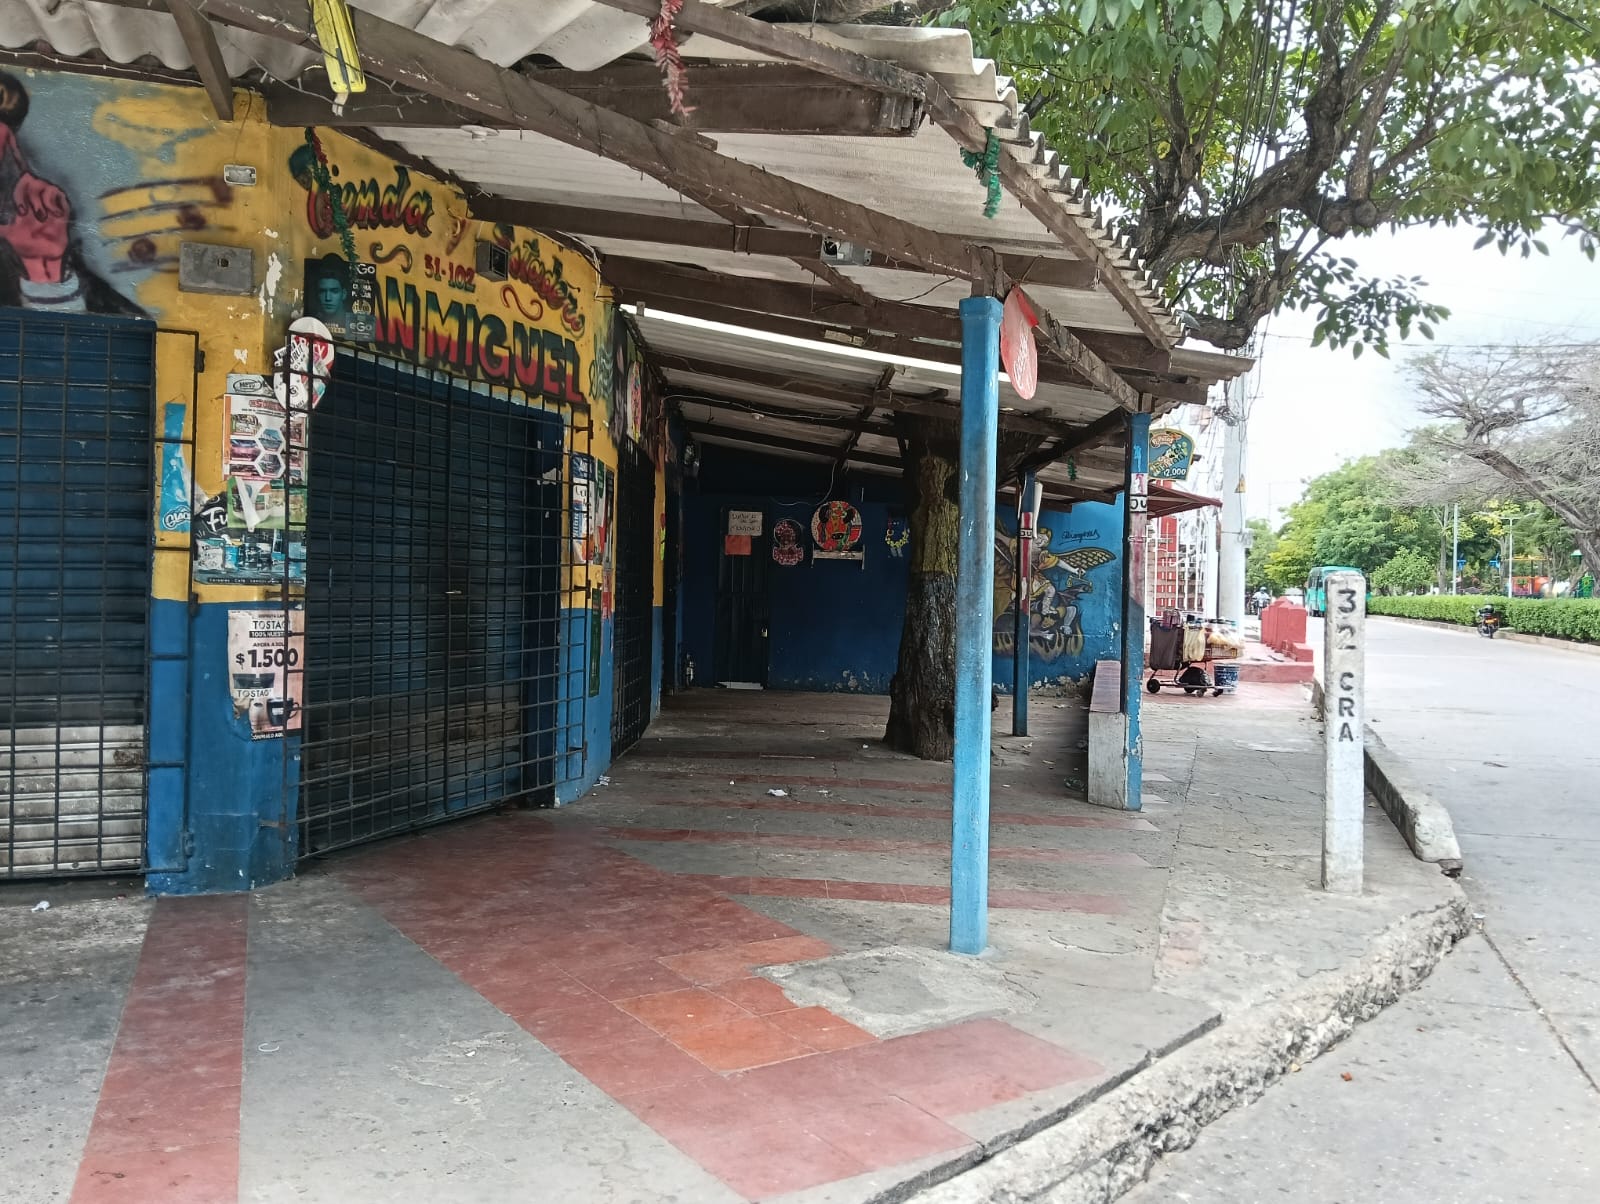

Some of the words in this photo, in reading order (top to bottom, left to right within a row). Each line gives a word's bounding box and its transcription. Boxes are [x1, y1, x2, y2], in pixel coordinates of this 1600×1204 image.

[424, 288, 590, 406] MIGUEL
[201, 506, 228, 532] Fu
[247, 648, 299, 668] 1.500
[1338, 671, 1355, 743] CRA
